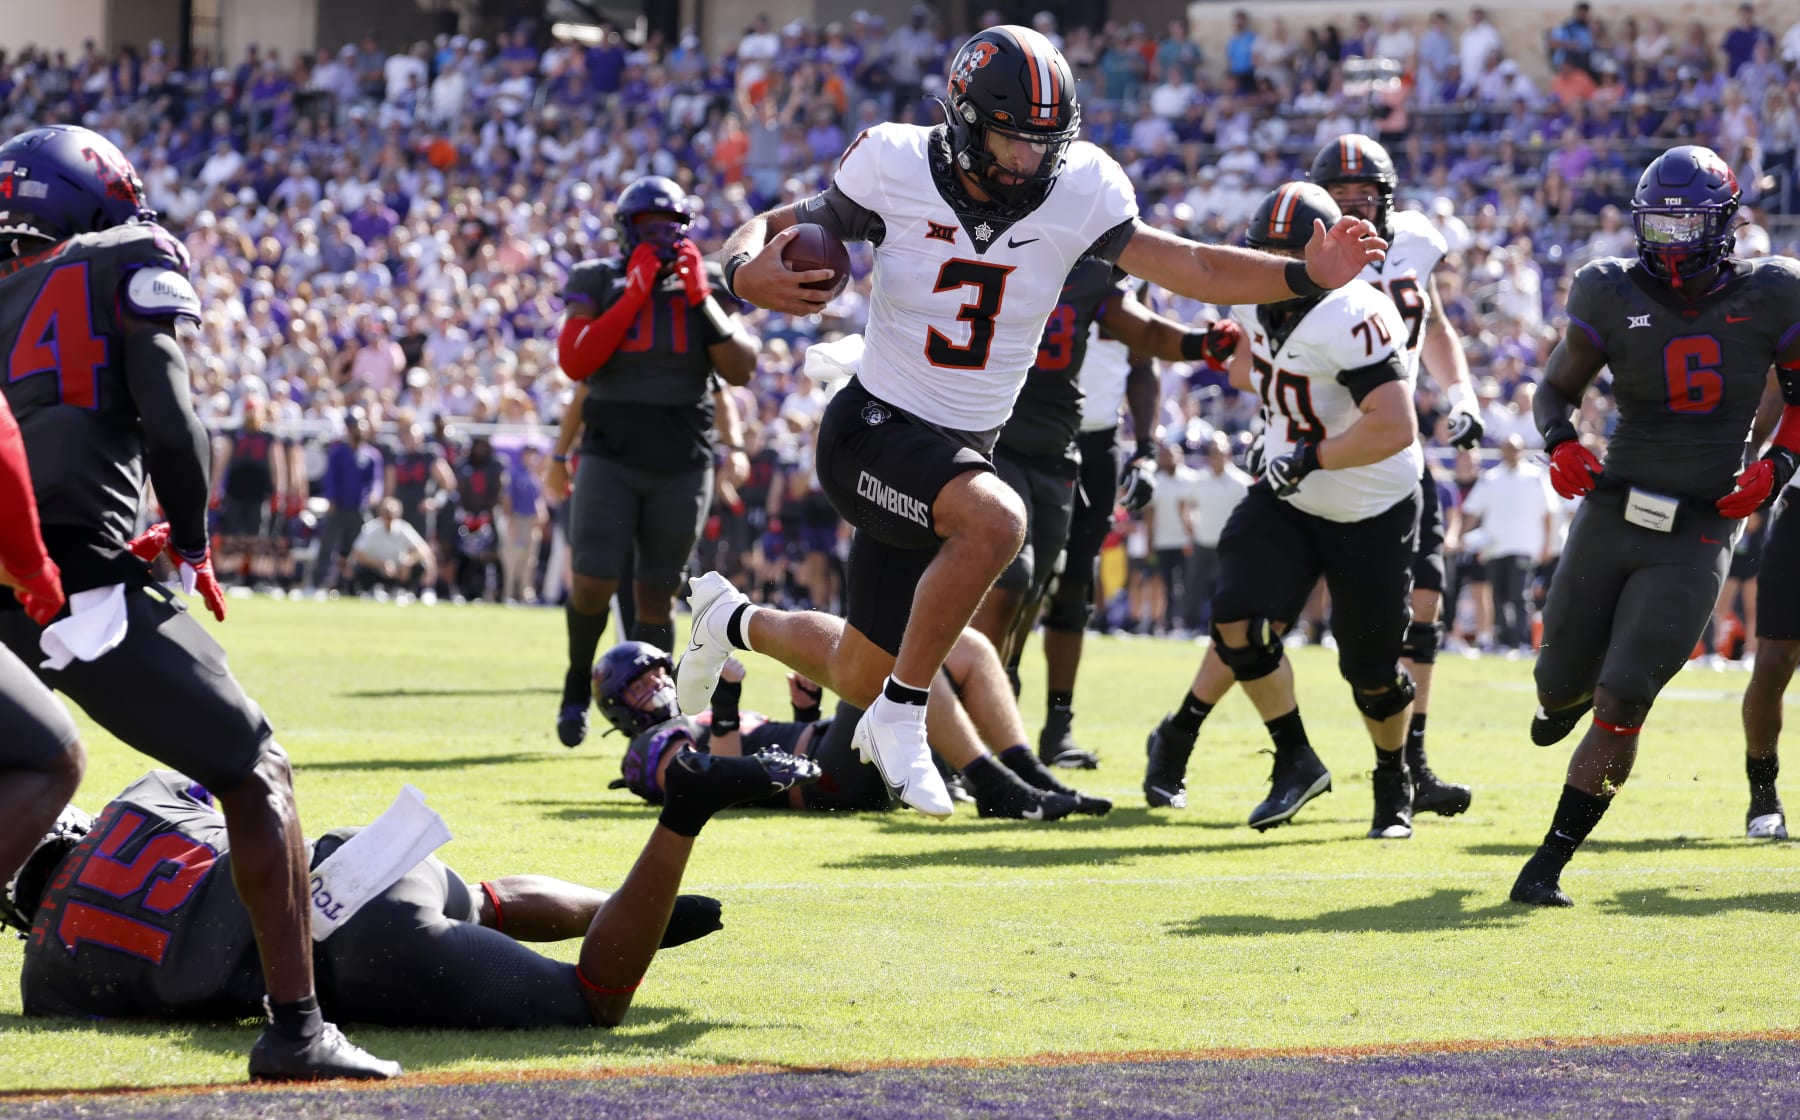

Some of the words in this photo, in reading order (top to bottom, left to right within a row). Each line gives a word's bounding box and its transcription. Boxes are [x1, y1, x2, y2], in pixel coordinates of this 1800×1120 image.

[1664, 198, 1682, 206] TCU
[925, 220, 959, 245] XII
[8, 261, 108, 411] 4
[924, 257, 1017, 370] 3
[1352, 312, 1392, 357] 70
[1370, 276, 1425, 351] 9
[1627, 314, 1651, 329] XII
[1251, 352, 1327, 447] 70
[1664, 334, 1723, 415] 6
[857, 470, 929, 529] COWBOYS
[57, 809, 217, 967] 15
[311, 877, 344, 921] TCU
[31, 919, 51, 946] J.
